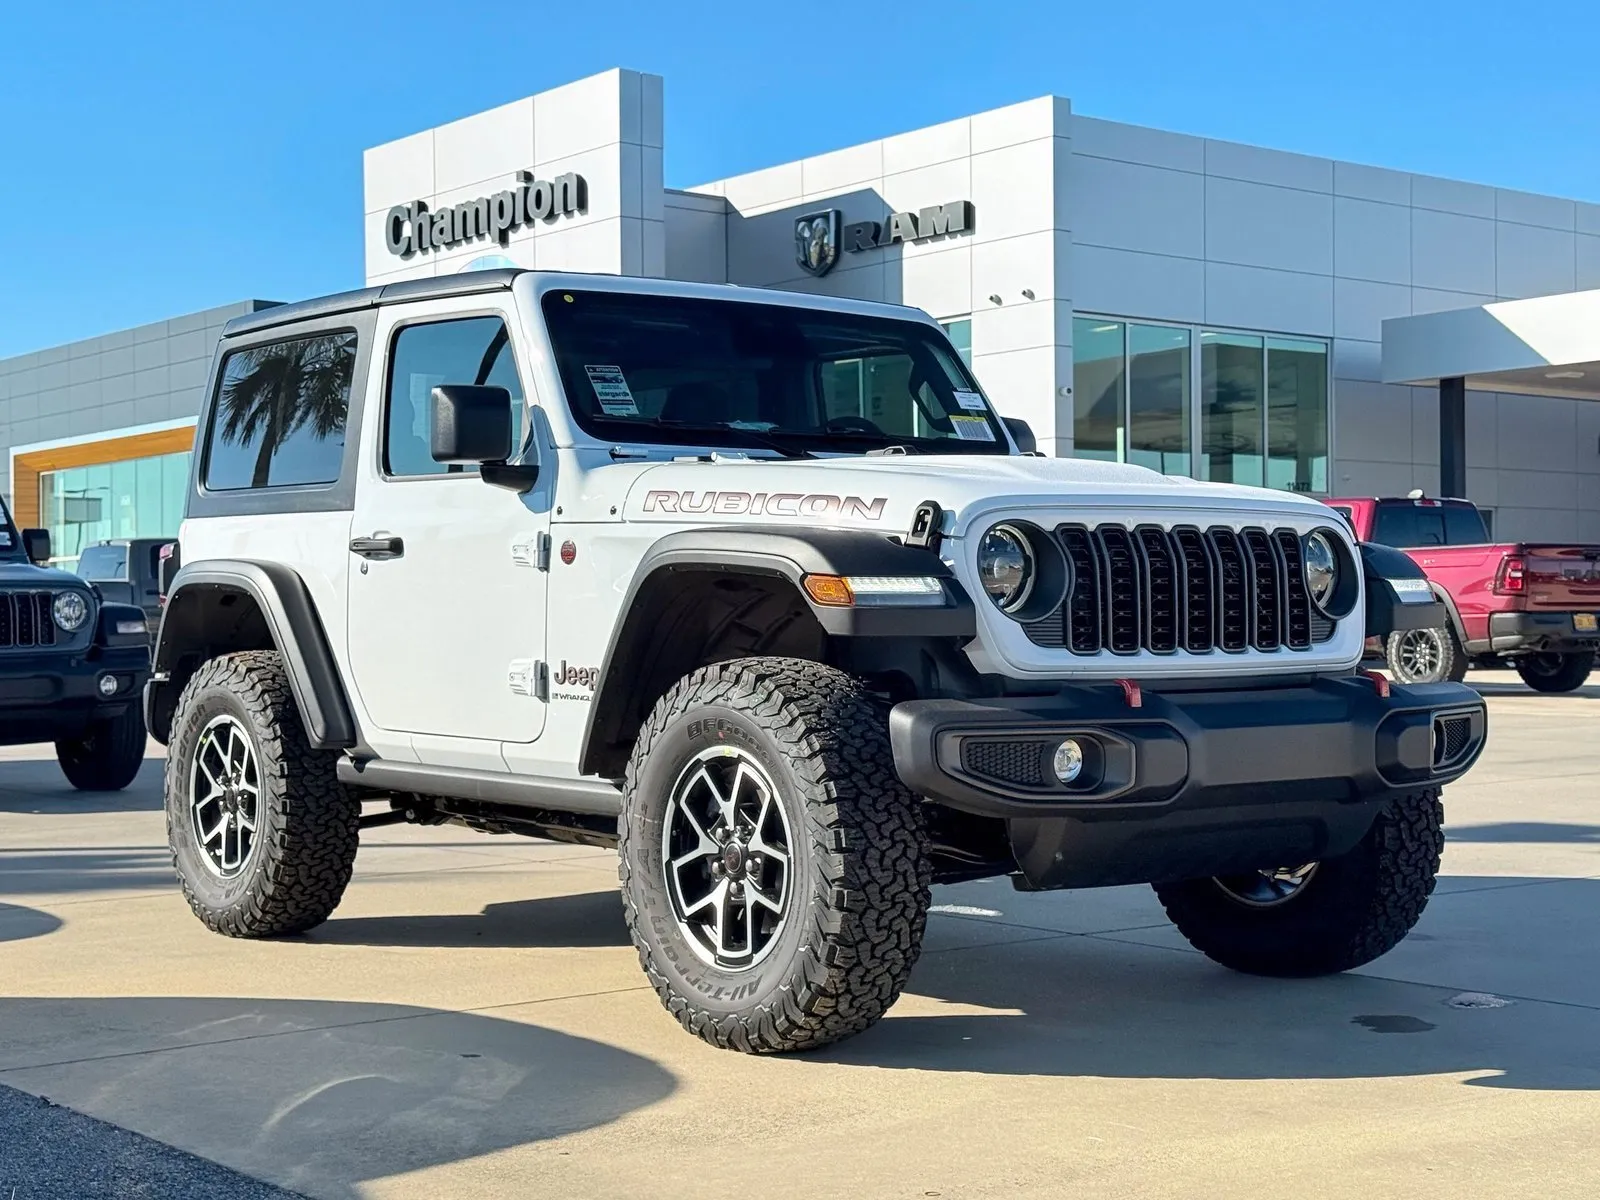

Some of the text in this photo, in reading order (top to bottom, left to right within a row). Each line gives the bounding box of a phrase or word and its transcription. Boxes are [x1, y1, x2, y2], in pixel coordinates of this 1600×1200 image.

[385, 170, 588, 260] Champion
[844, 200, 975, 253] RAM
[643, 490, 888, 520] RUBICON
[554, 660, 600, 691] Jeep
[559, 693, 593, 701] WRANGL
[651, 916, 763, 1001] All-Terrain
